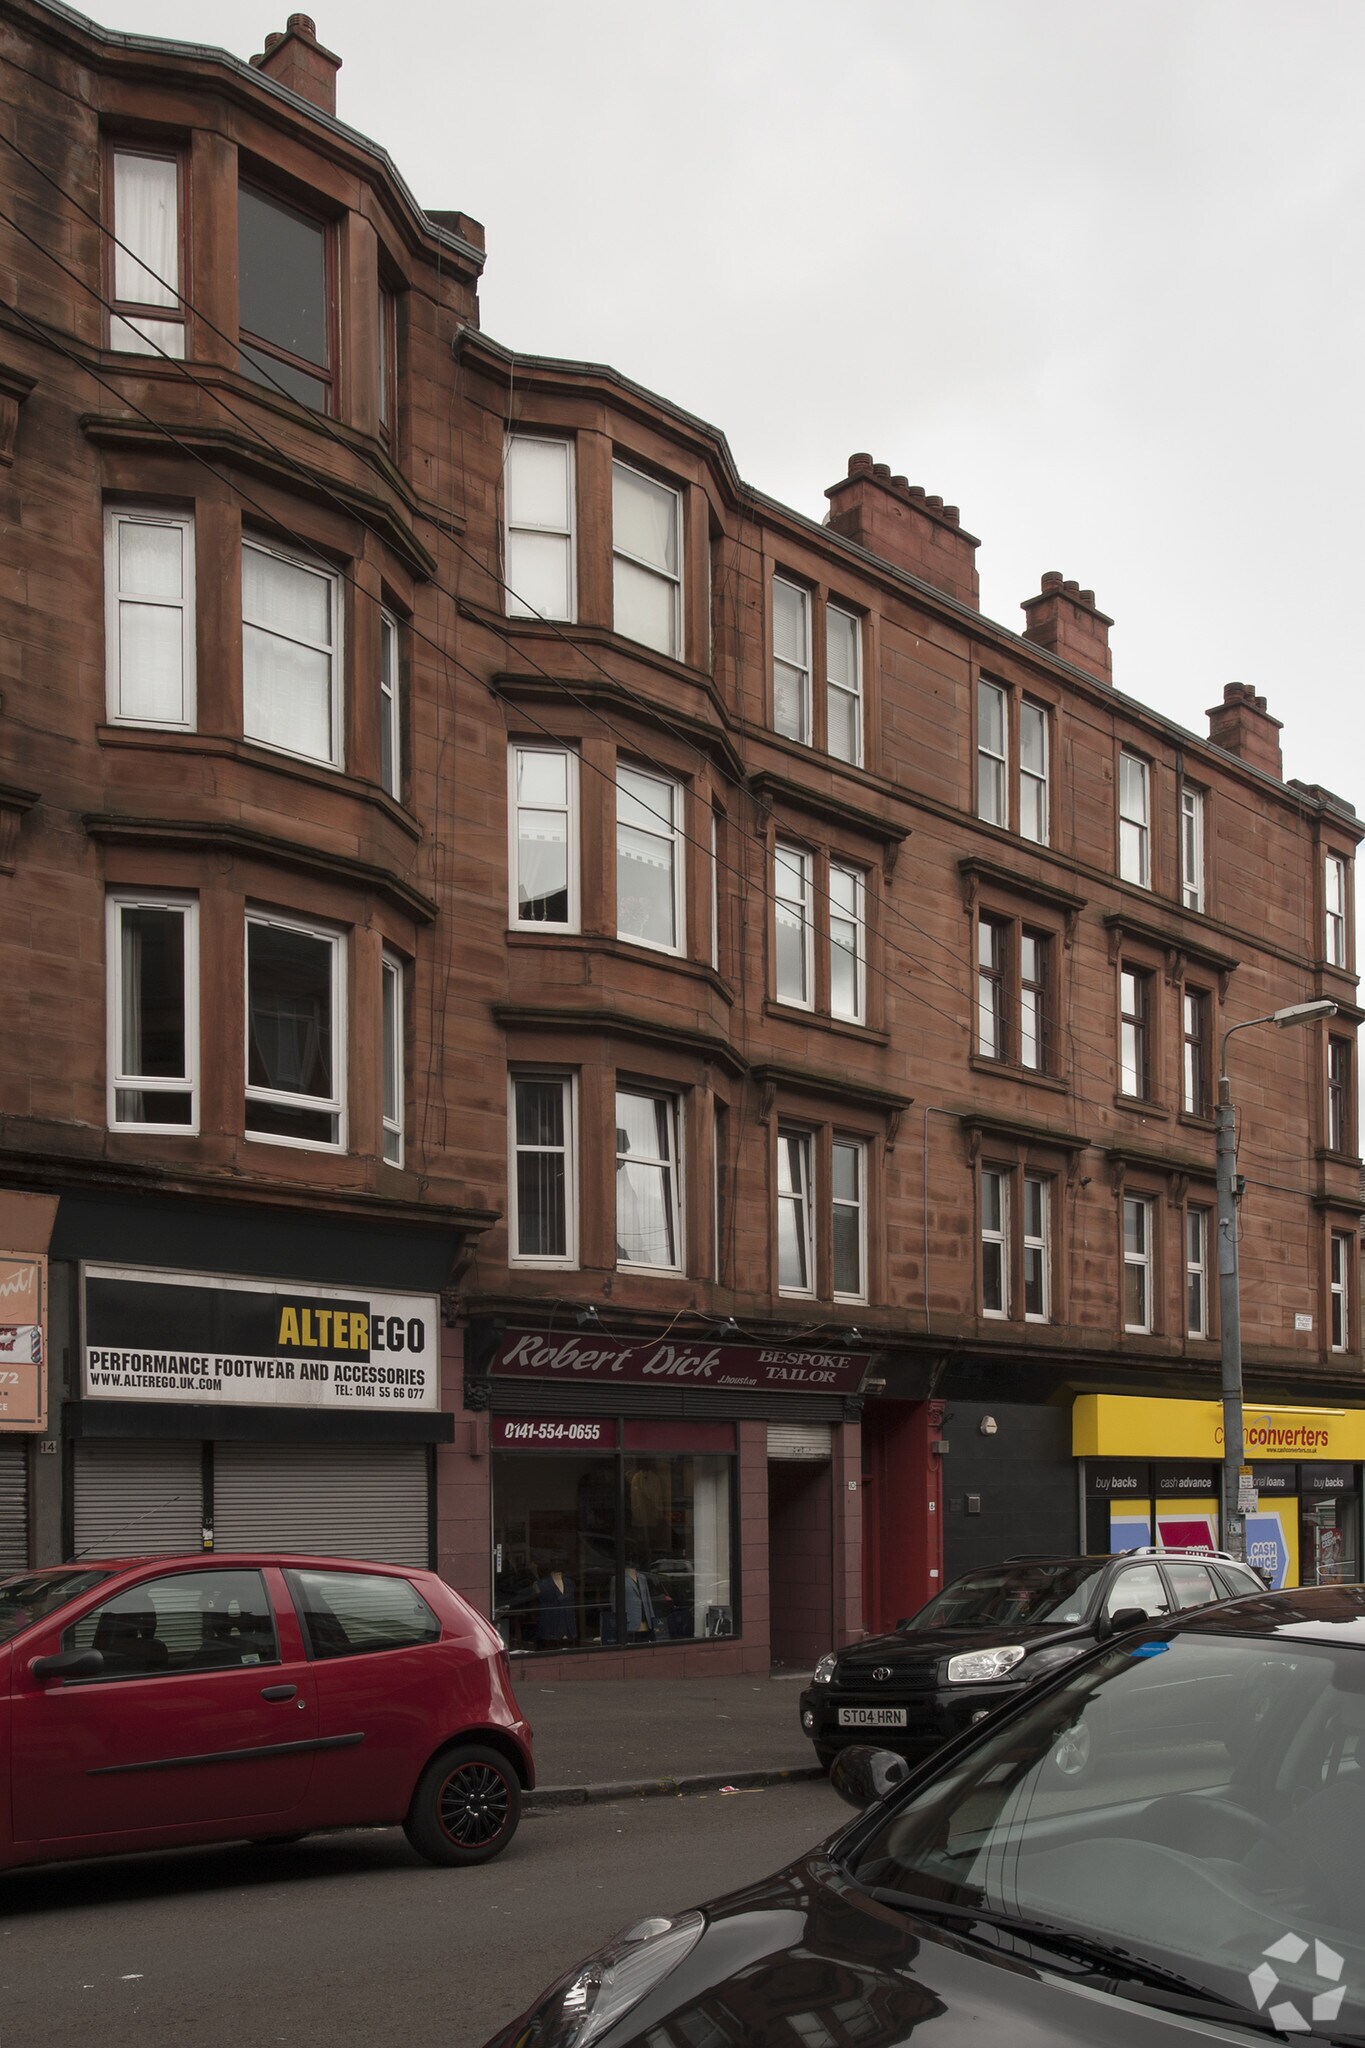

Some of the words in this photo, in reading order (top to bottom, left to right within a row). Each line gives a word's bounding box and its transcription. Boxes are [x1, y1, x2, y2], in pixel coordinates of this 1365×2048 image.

[502, 1335, 632, 1371] Robert
[642, 1345, 722, 1377] Dick
[757, 1350, 851, 1369] BESPOKE
[89, 1351, 209, 1375] PERFORMANCE
[214, 1358, 295, 1380] FOOTWEAR
[300, 1363, 329, 1381] AND
[333, 1365, 425, 1386] ACCESSORIES
[765, 1366, 837, 1383] TAILOR
[90, 1372, 222, 1391] WWW.ALTEREGO.UK.COM
[335, 1384, 353, 1396] TEL:
[355, 1385, 375, 1398] 0141
[379, 1386, 391, 1398] 55
[393, 1387, 405, 1398] 66
[407, 1388, 425, 1400] 077
[504, 1422, 600, 1440] 0141-554-0655
[42, 1442, 55, 1452] 14
[1095, 1477, 1111, 1490] buy
[1111, 1476, 1138, 1488] backs
[1160, 1477, 1178, 1488] cash
[1178, 1476, 1212, 1488] advance
[1266, 1476, 1286, 1487] loans
[1313, 1477, 1325, 1490] buy
[1325, 1477, 1344, 1487] backs
[1251, 1543, 1277, 1556] CASH
[843, 1709, 875, 1723] ST04
[877, 1710, 902, 1723] HRN
